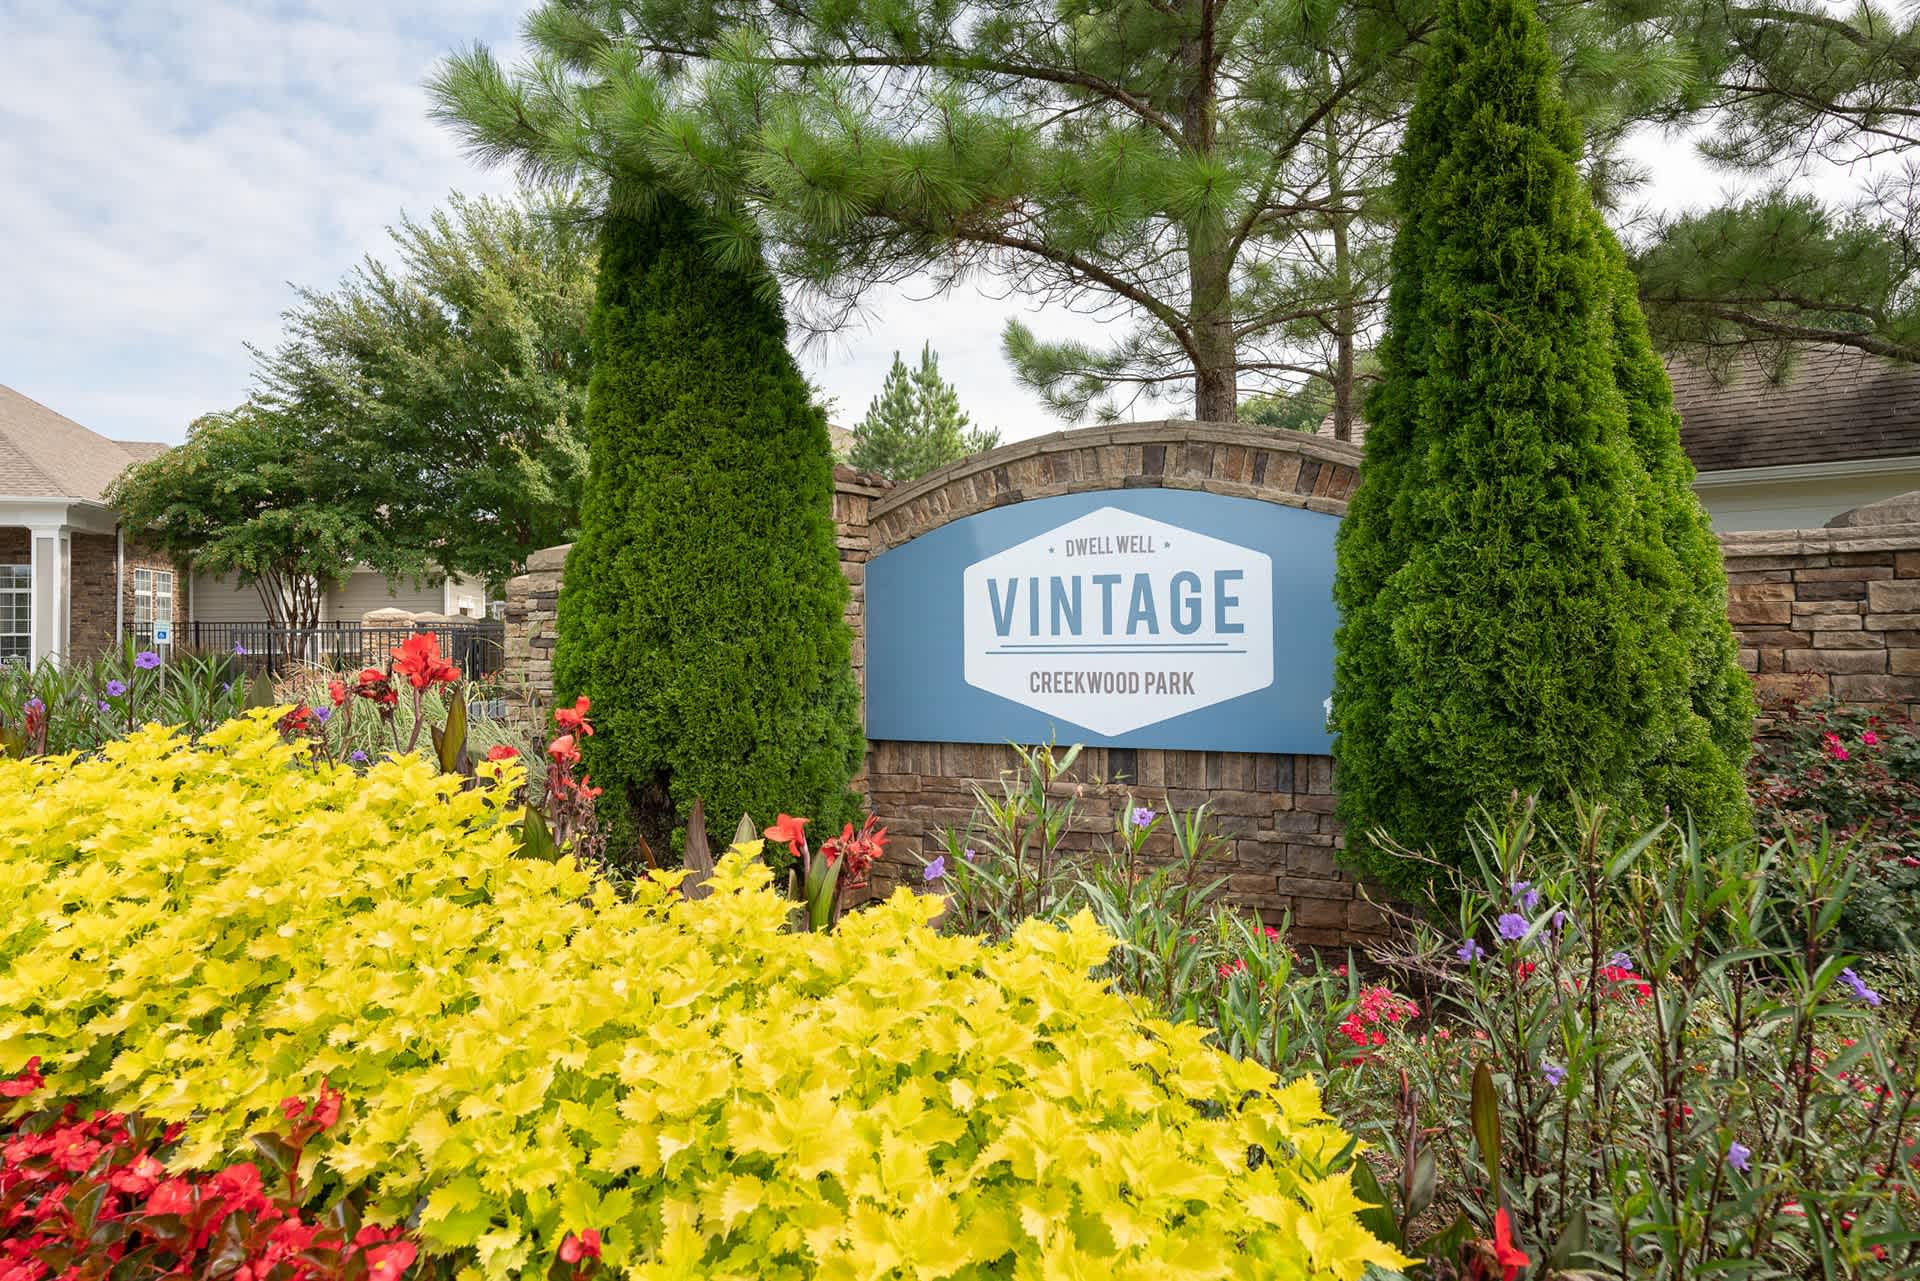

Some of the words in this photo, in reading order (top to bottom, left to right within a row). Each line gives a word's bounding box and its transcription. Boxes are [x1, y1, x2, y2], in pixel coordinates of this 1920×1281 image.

[1065, 536, 1113, 557] DWELL
[1116, 536, 1155, 553] WELL
[987, 570, 1244, 636] VINTAGE
[1030, 671, 1140, 695] CREEKWOOD
[1144, 672, 1195, 695] PARK
